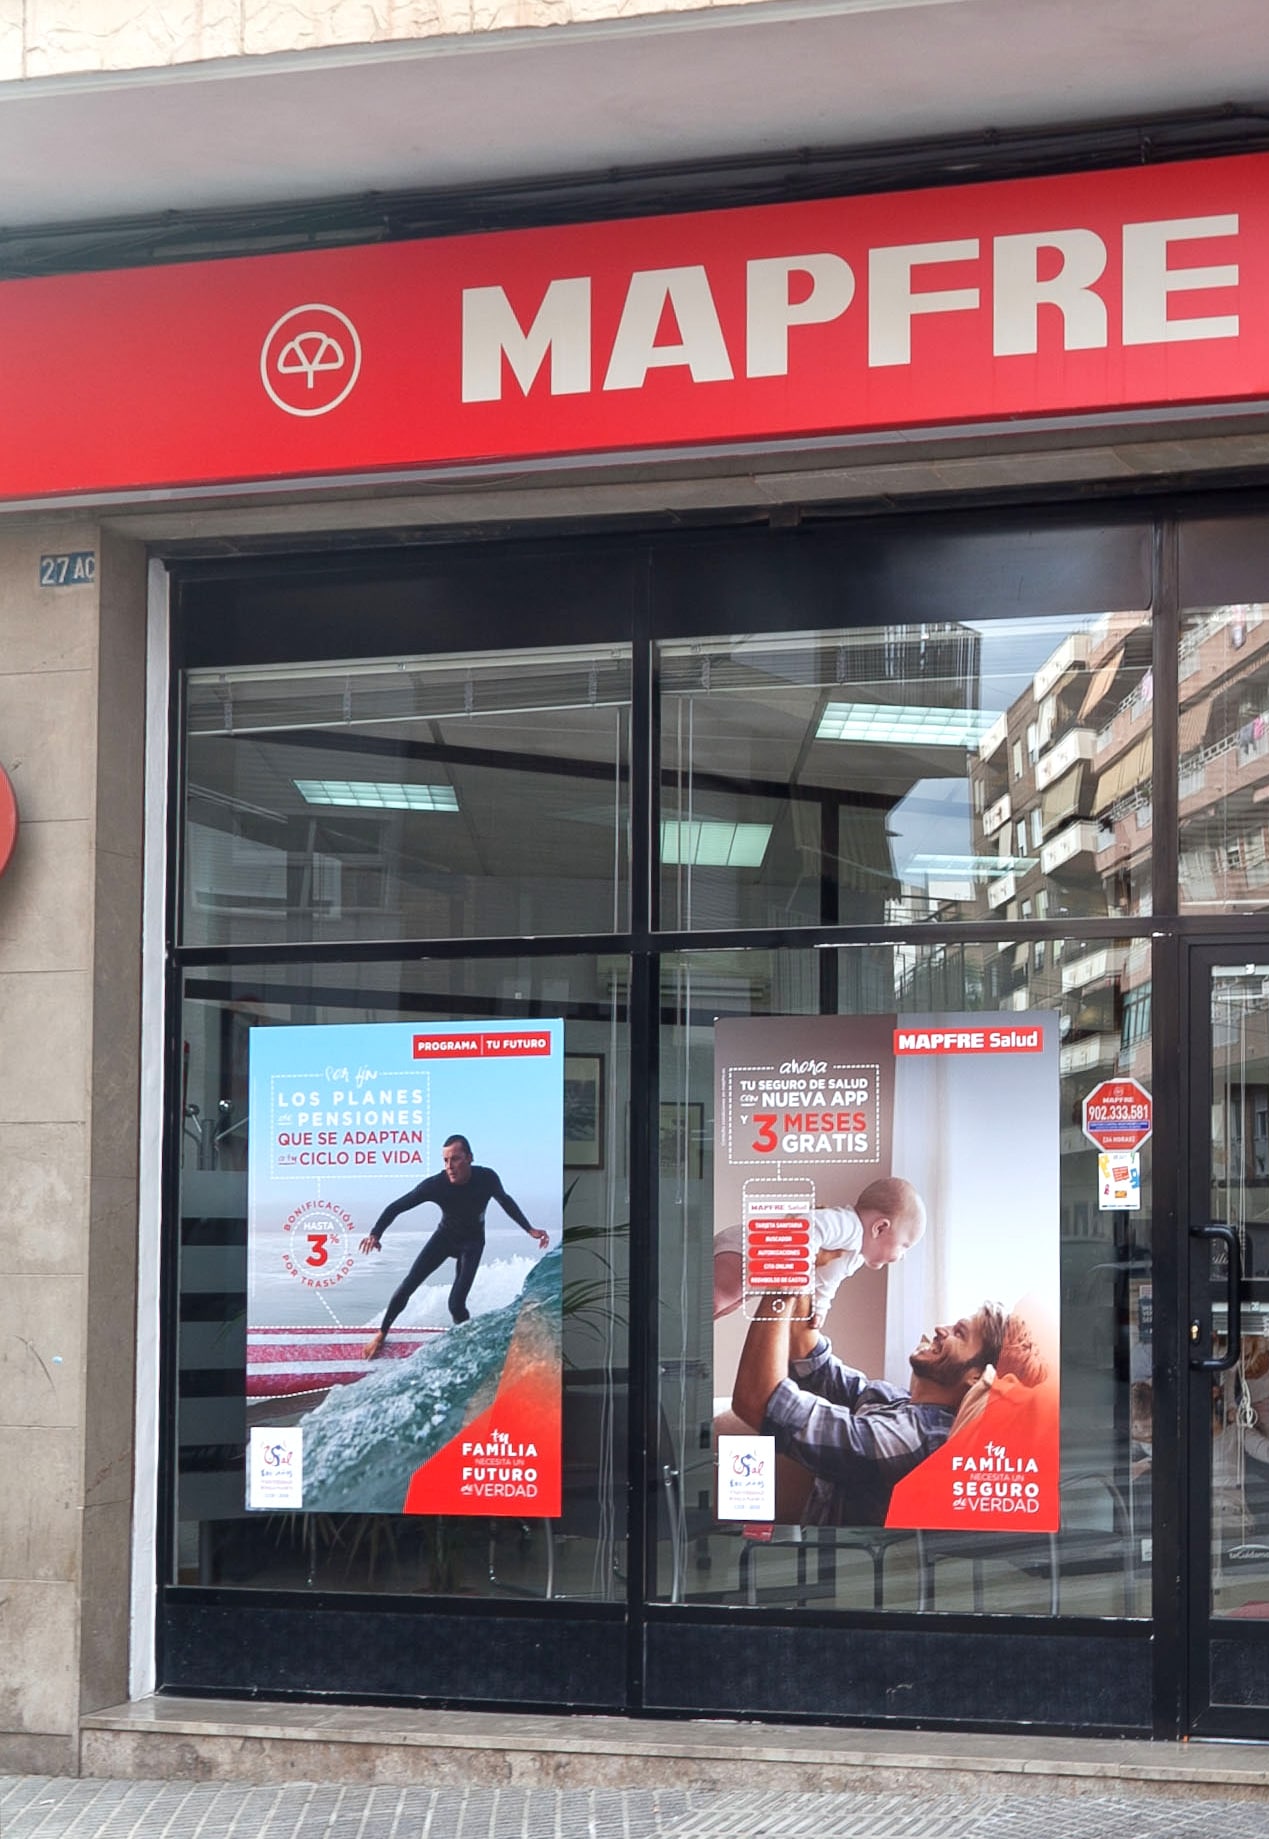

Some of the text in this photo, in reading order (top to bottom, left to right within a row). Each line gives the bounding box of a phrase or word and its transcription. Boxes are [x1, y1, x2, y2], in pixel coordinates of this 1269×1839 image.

[461, 213, 1239, 404] MAPFRE
[42, 557, 70, 585] 27
[418, 1039, 547, 1051] PROGRAMA TU FUTURO
[898, 1030, 1038, 1050] MAPFRE Salud
[779, 1058, 828, 1075] ahora
[740, 1077, 868, 1091] TU SEGURO DE SALUD
[278, 1089, 423, 1107] LOS PLANES
[762, 1092, 826, 1108] NUEVA
[831, 1091, 868, 1107] APP
[298, 1110, 423, 1126] PENSIONES
[1088, 1104, 1149, 1121] 902.333.581
[278, 1130, 423, 1146] QUE SE ADAPTAN
[740, 1111, 867, 1153] Y 3 MESES
[782, 1133, 869, 1153] GRATIS
[299, 1151, 348, 1166] CICLO
[355, 1151, 376, 1164] DE
[381, 1150, 423, 1164] VIDA
[303, 1221, 334, 1231] HASTA
[283, 1254, 298, 1277] POR
[462, 1442, 538, 1457] FAMILIA
[952, 1457, 1039, 1473] FAMILIA
[462, 1467, 538, 1482] FUTURO
[970, 1473, 1010, 1481] NECESITA
[474, 1483, 538, 1498] VERDAD
[952, 1481, 1039, 1497] SEGURO
[967, 1497, 1040, 1513] VERDAD
